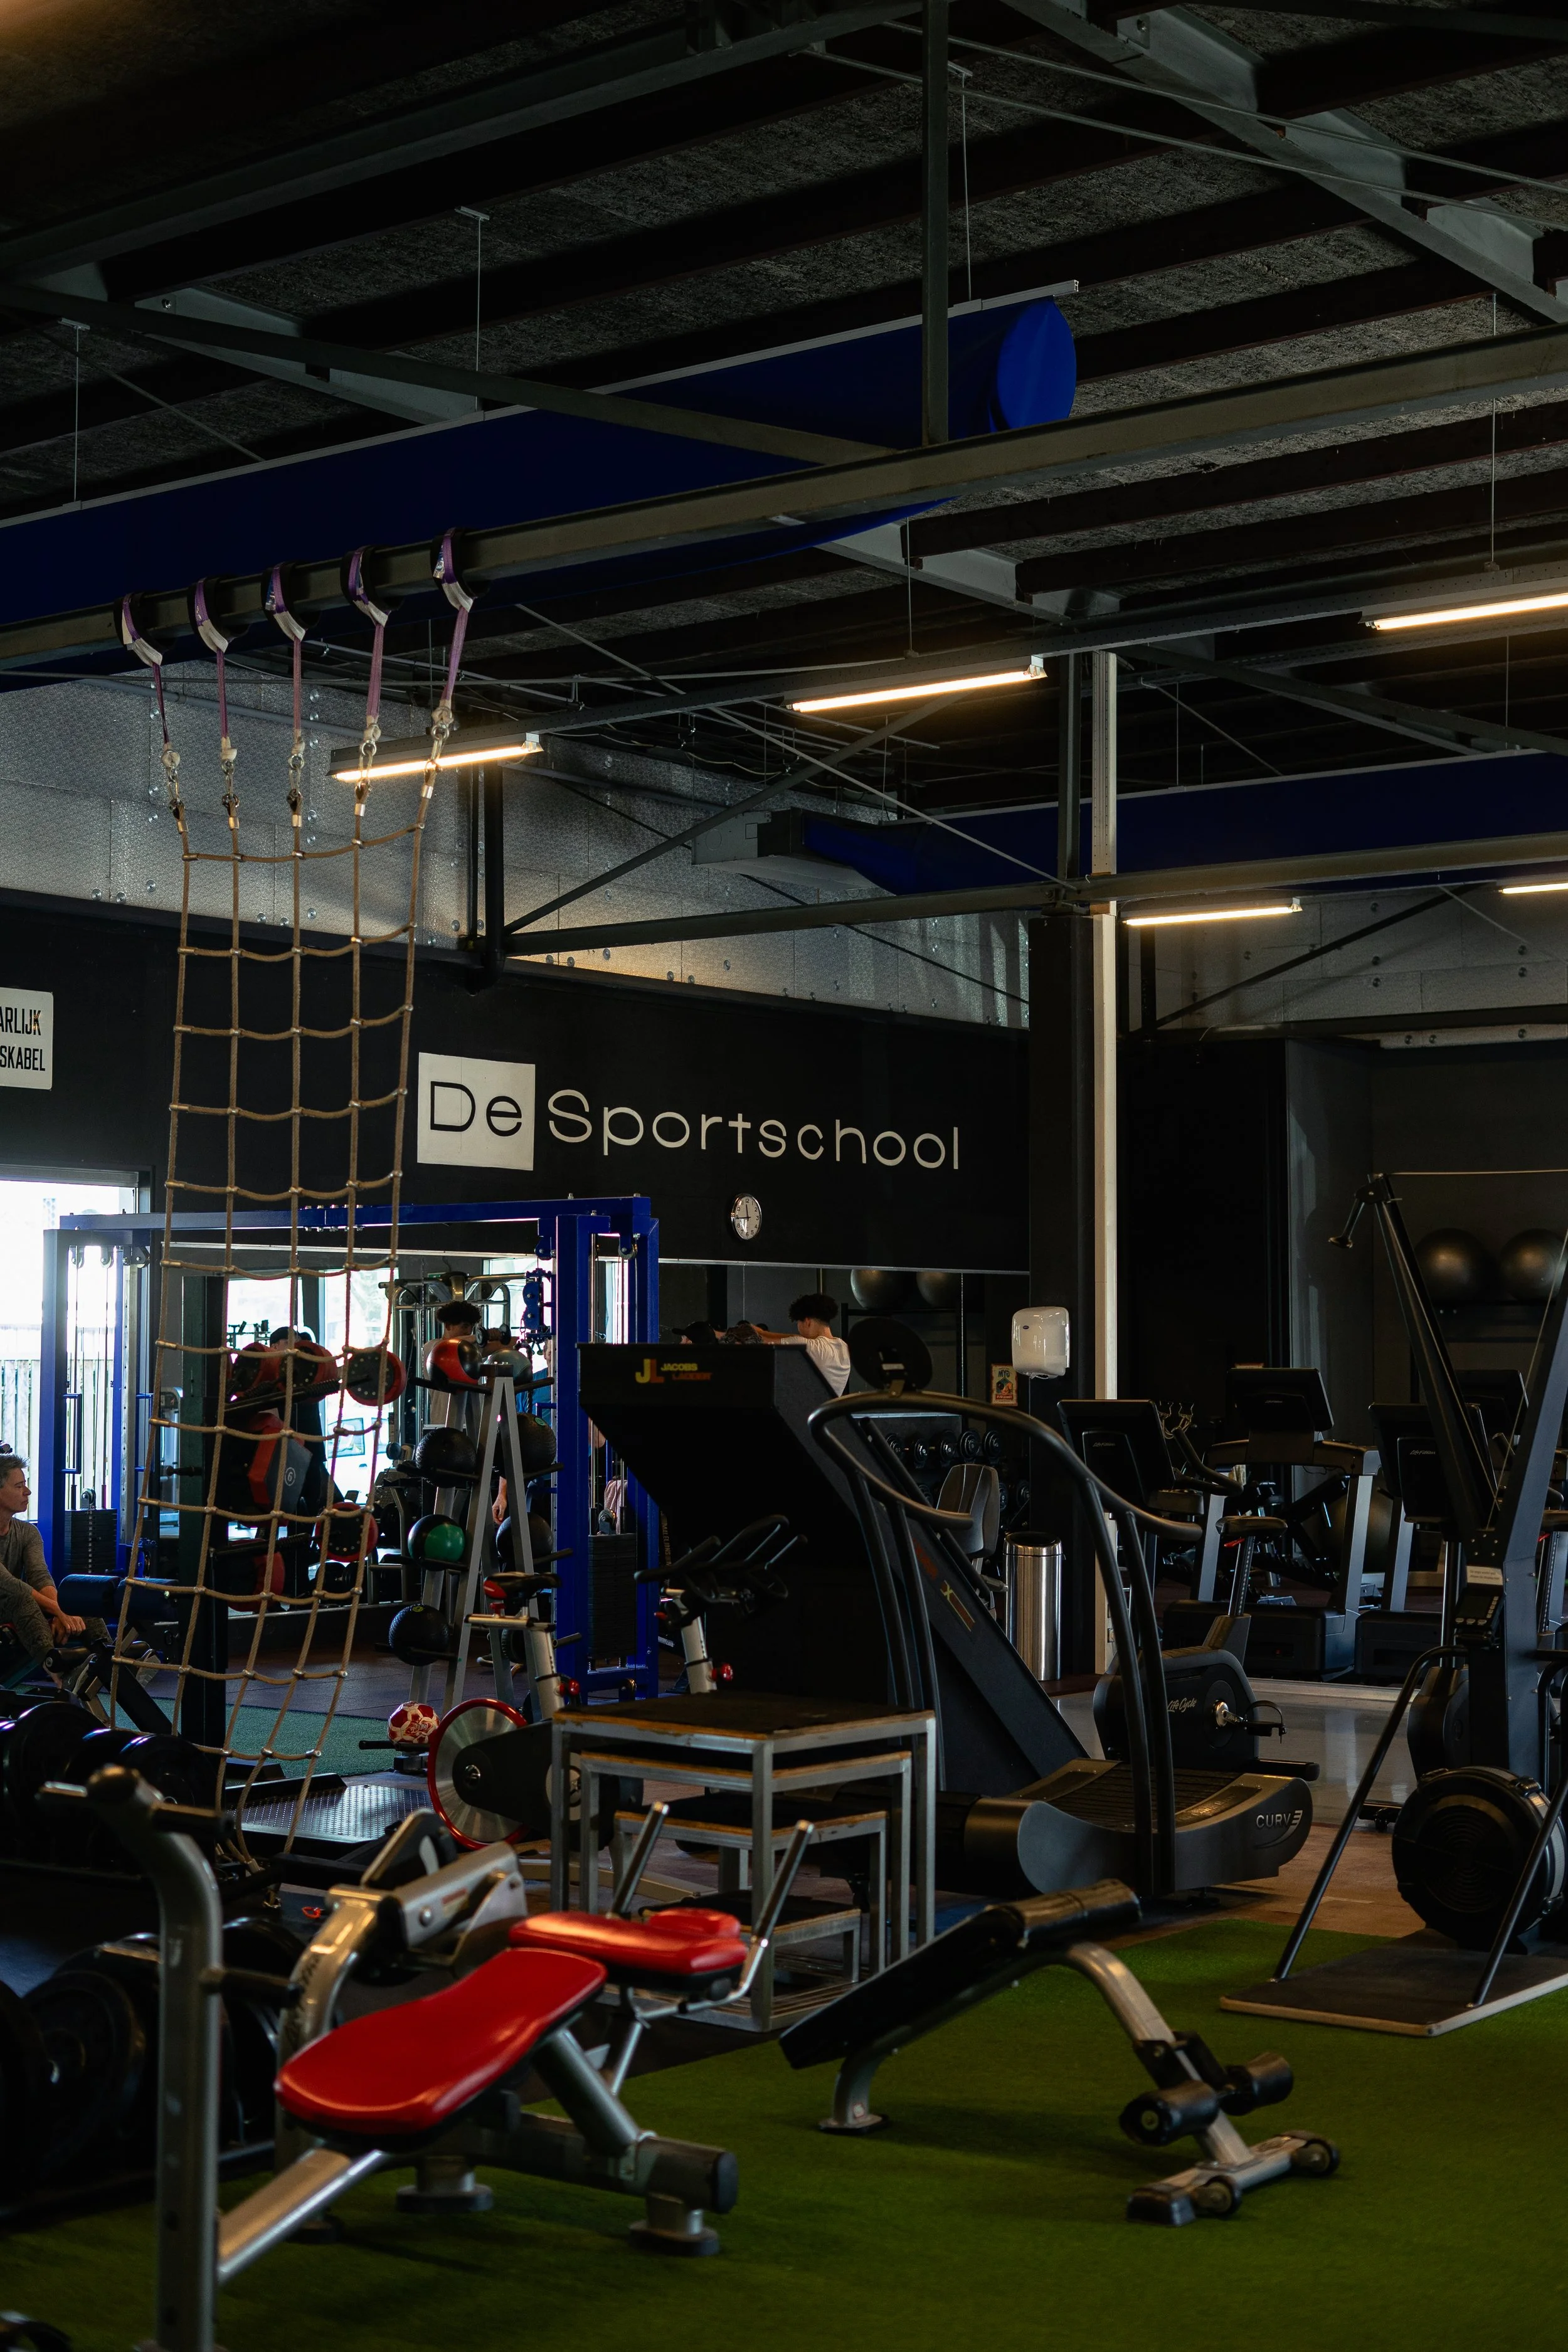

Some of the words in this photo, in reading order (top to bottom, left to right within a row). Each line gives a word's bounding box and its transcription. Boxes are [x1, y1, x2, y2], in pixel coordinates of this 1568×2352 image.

[0, 1046, 45, 1071] SKABEL
[430, 1081, 522, 1137] De
[548, 1089, 958, 1170] Sportschool
[660, 1362, 699, 1372] JACOBS
[288, 1471, 293, 1481] 6
